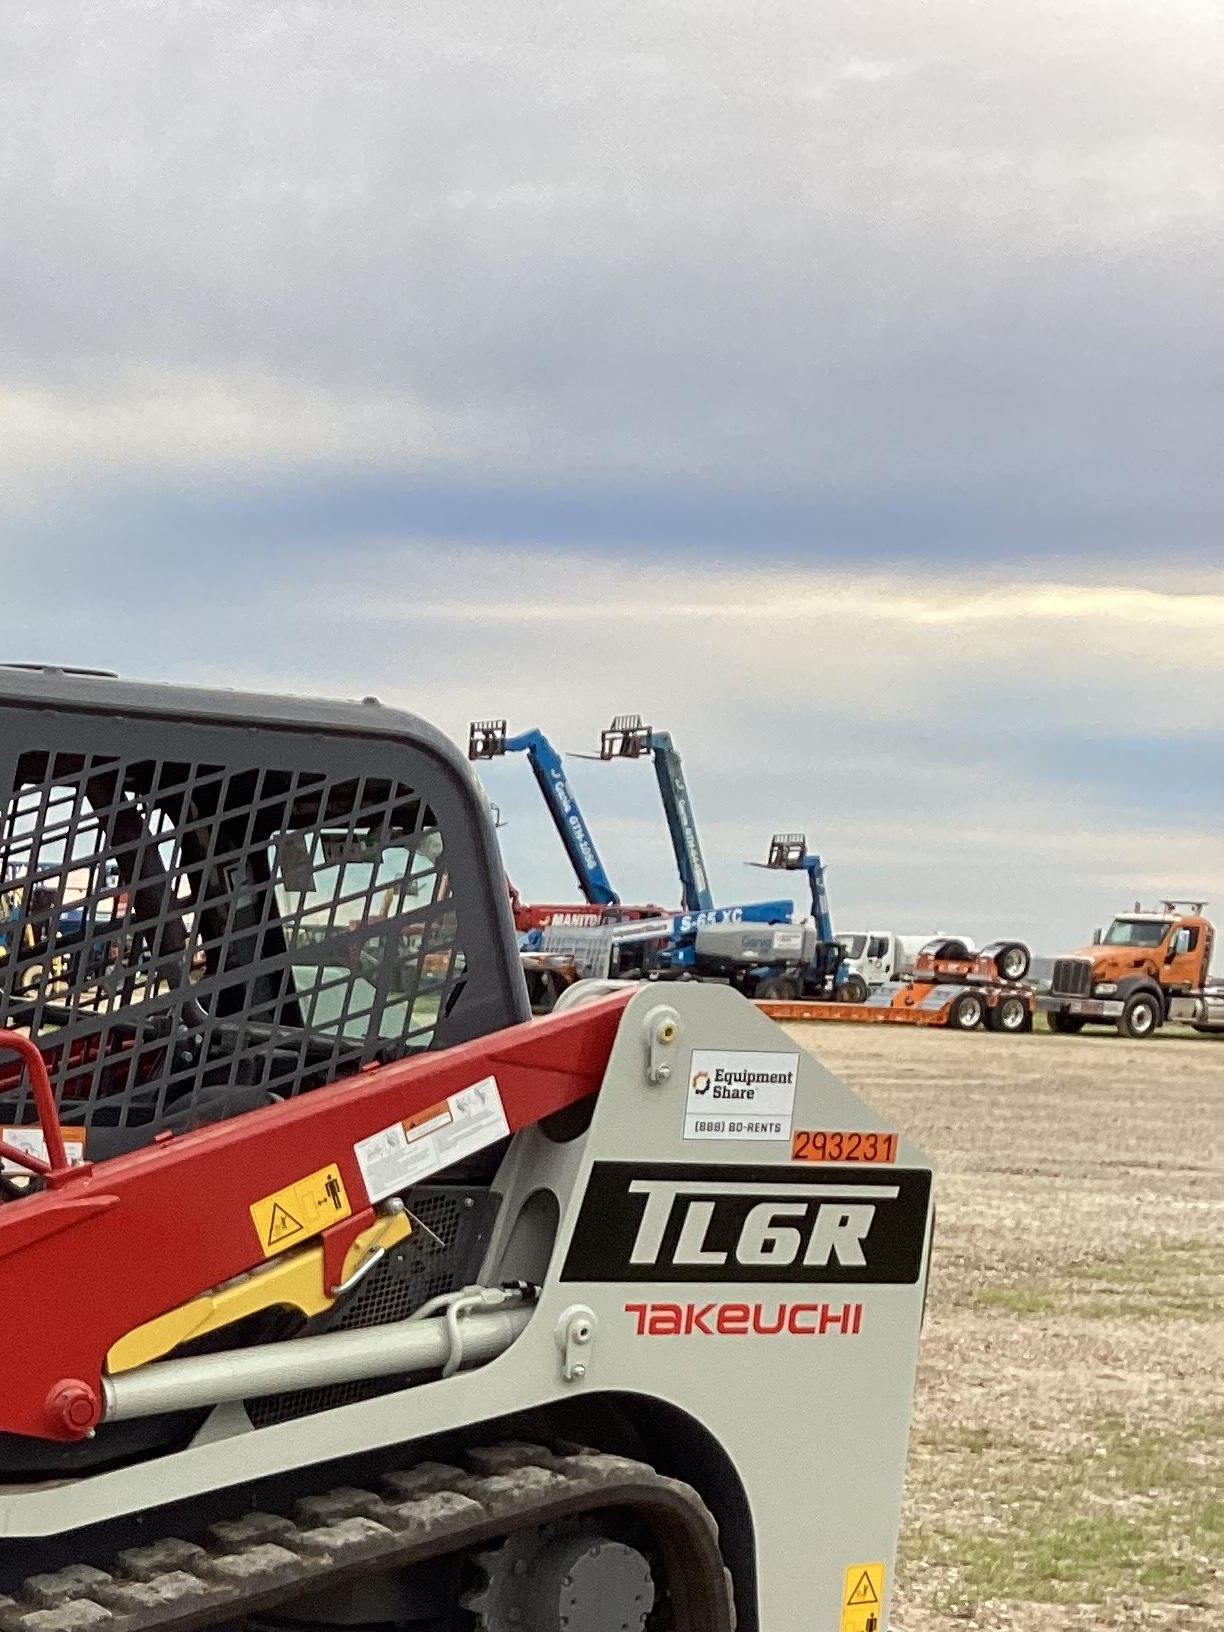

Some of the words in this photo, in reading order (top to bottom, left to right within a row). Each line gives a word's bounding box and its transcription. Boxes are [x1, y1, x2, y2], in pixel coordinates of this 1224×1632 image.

[714, 1068, 794, 1086] Equipment
[712, 1086, 755, 1100] Share
[694, 1121, 725, 1133] (888)
[728, 1121, 782, 1133] 80-RENTS
[793, 1131, 894, 1162] 293231
[628, 1179, 901, 1267] TL6R
